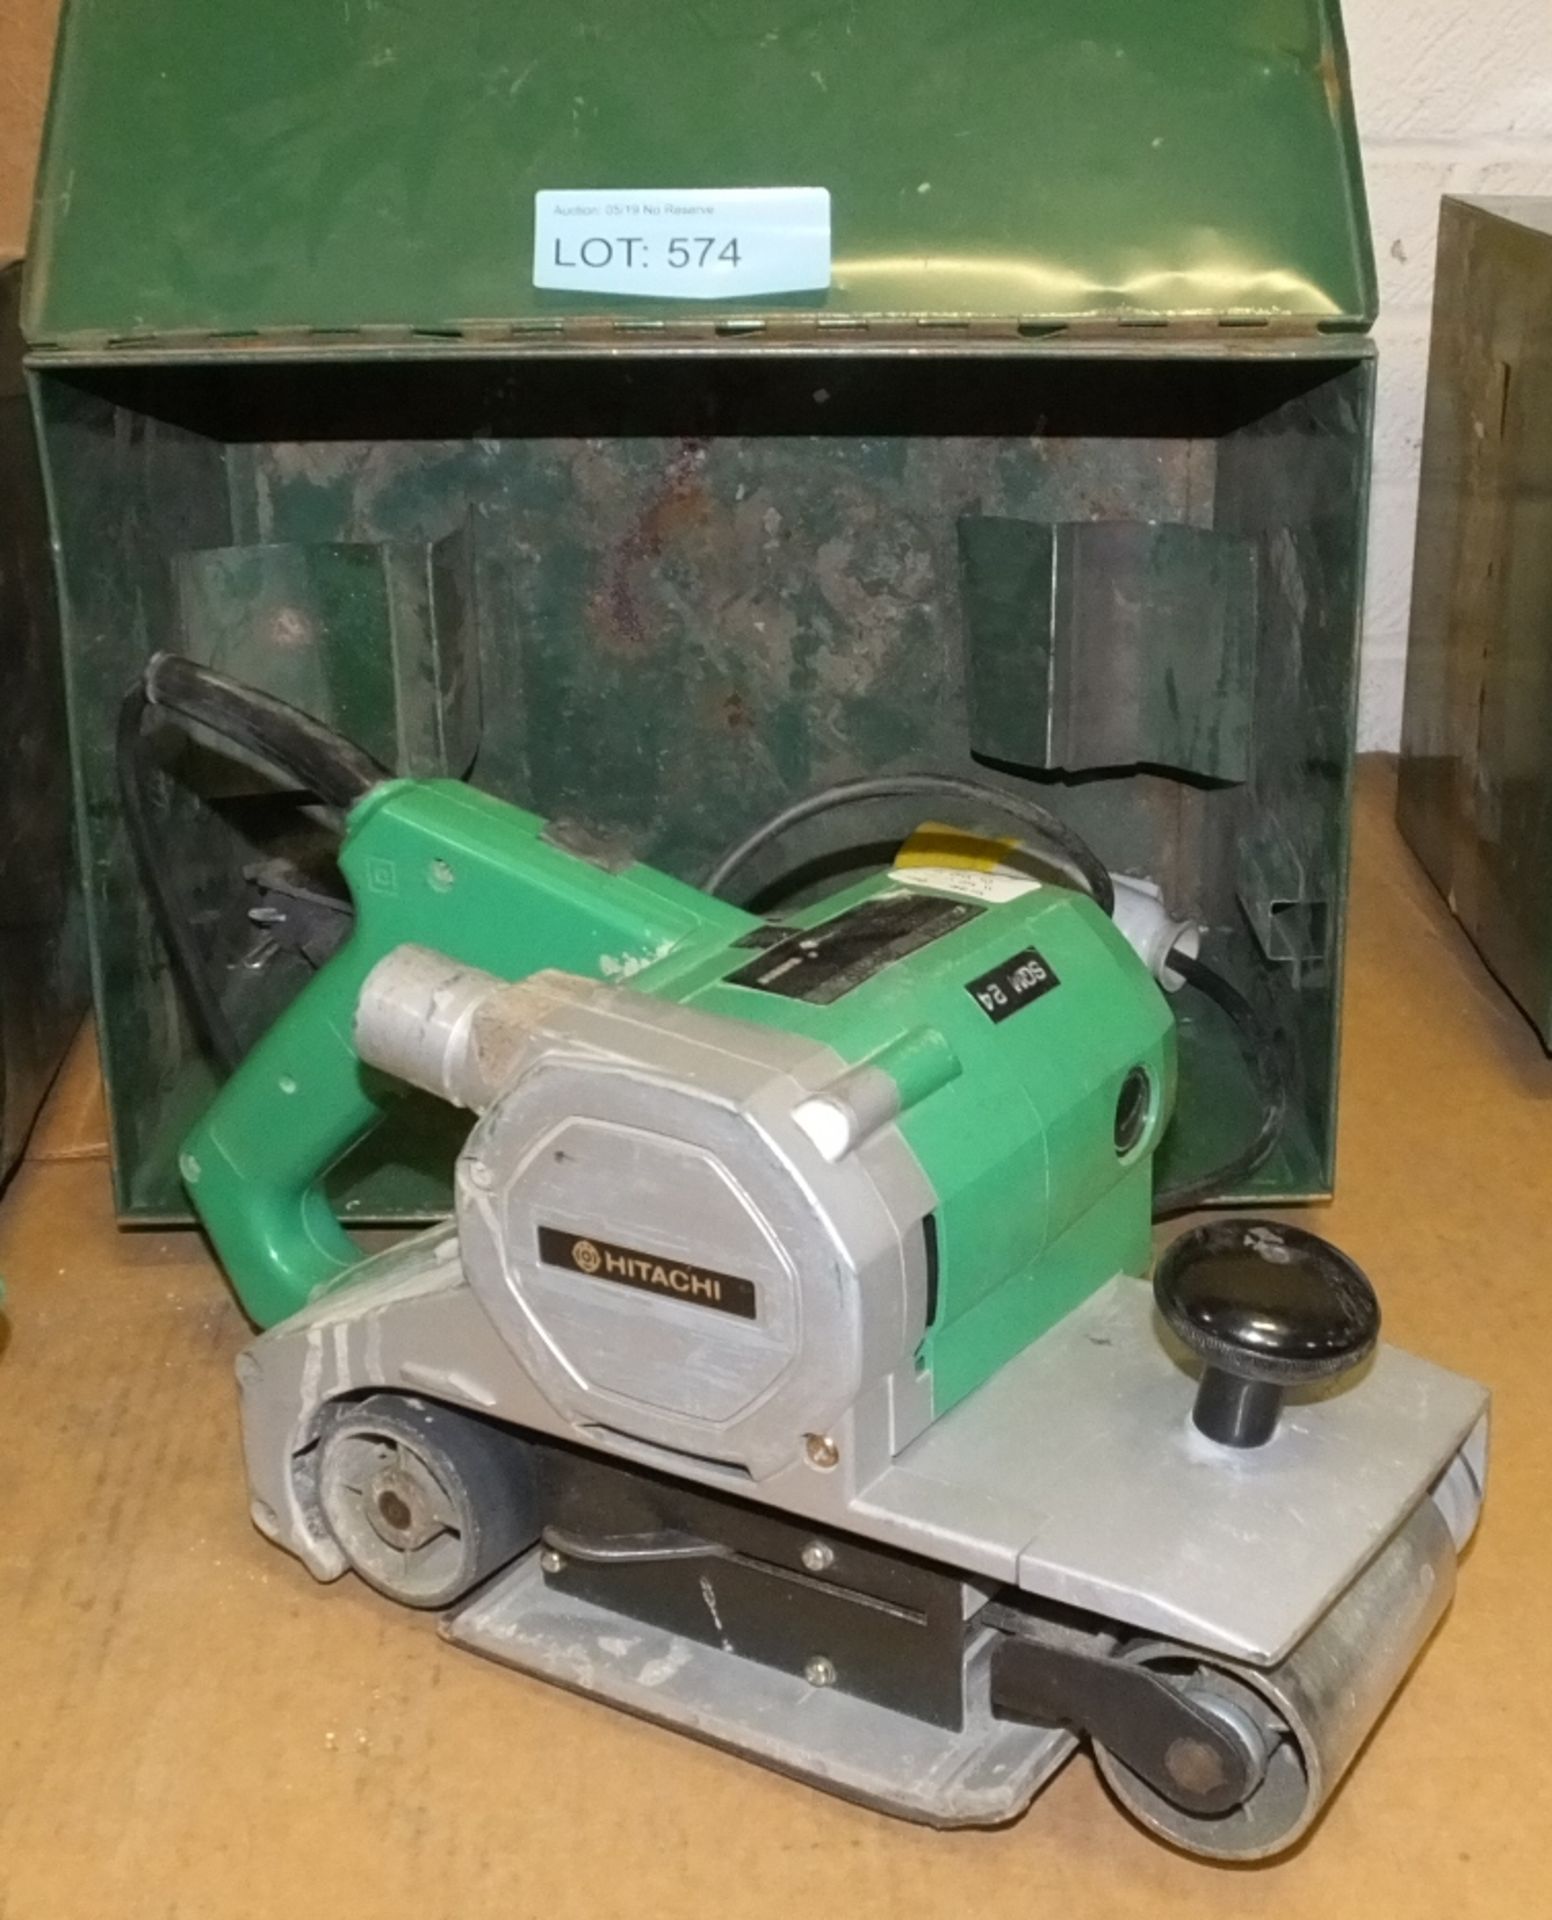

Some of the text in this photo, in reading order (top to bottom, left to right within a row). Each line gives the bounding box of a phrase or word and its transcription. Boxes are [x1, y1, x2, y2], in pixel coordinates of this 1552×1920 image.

[642, 205, 661, 216] No
[664, 203, 715, 215] Reserve
[554, 237, 741, 269] LOT: 574
[976, 983, 1008, 1011] 24
[604, 1251, 721, 1301] HITACHI
